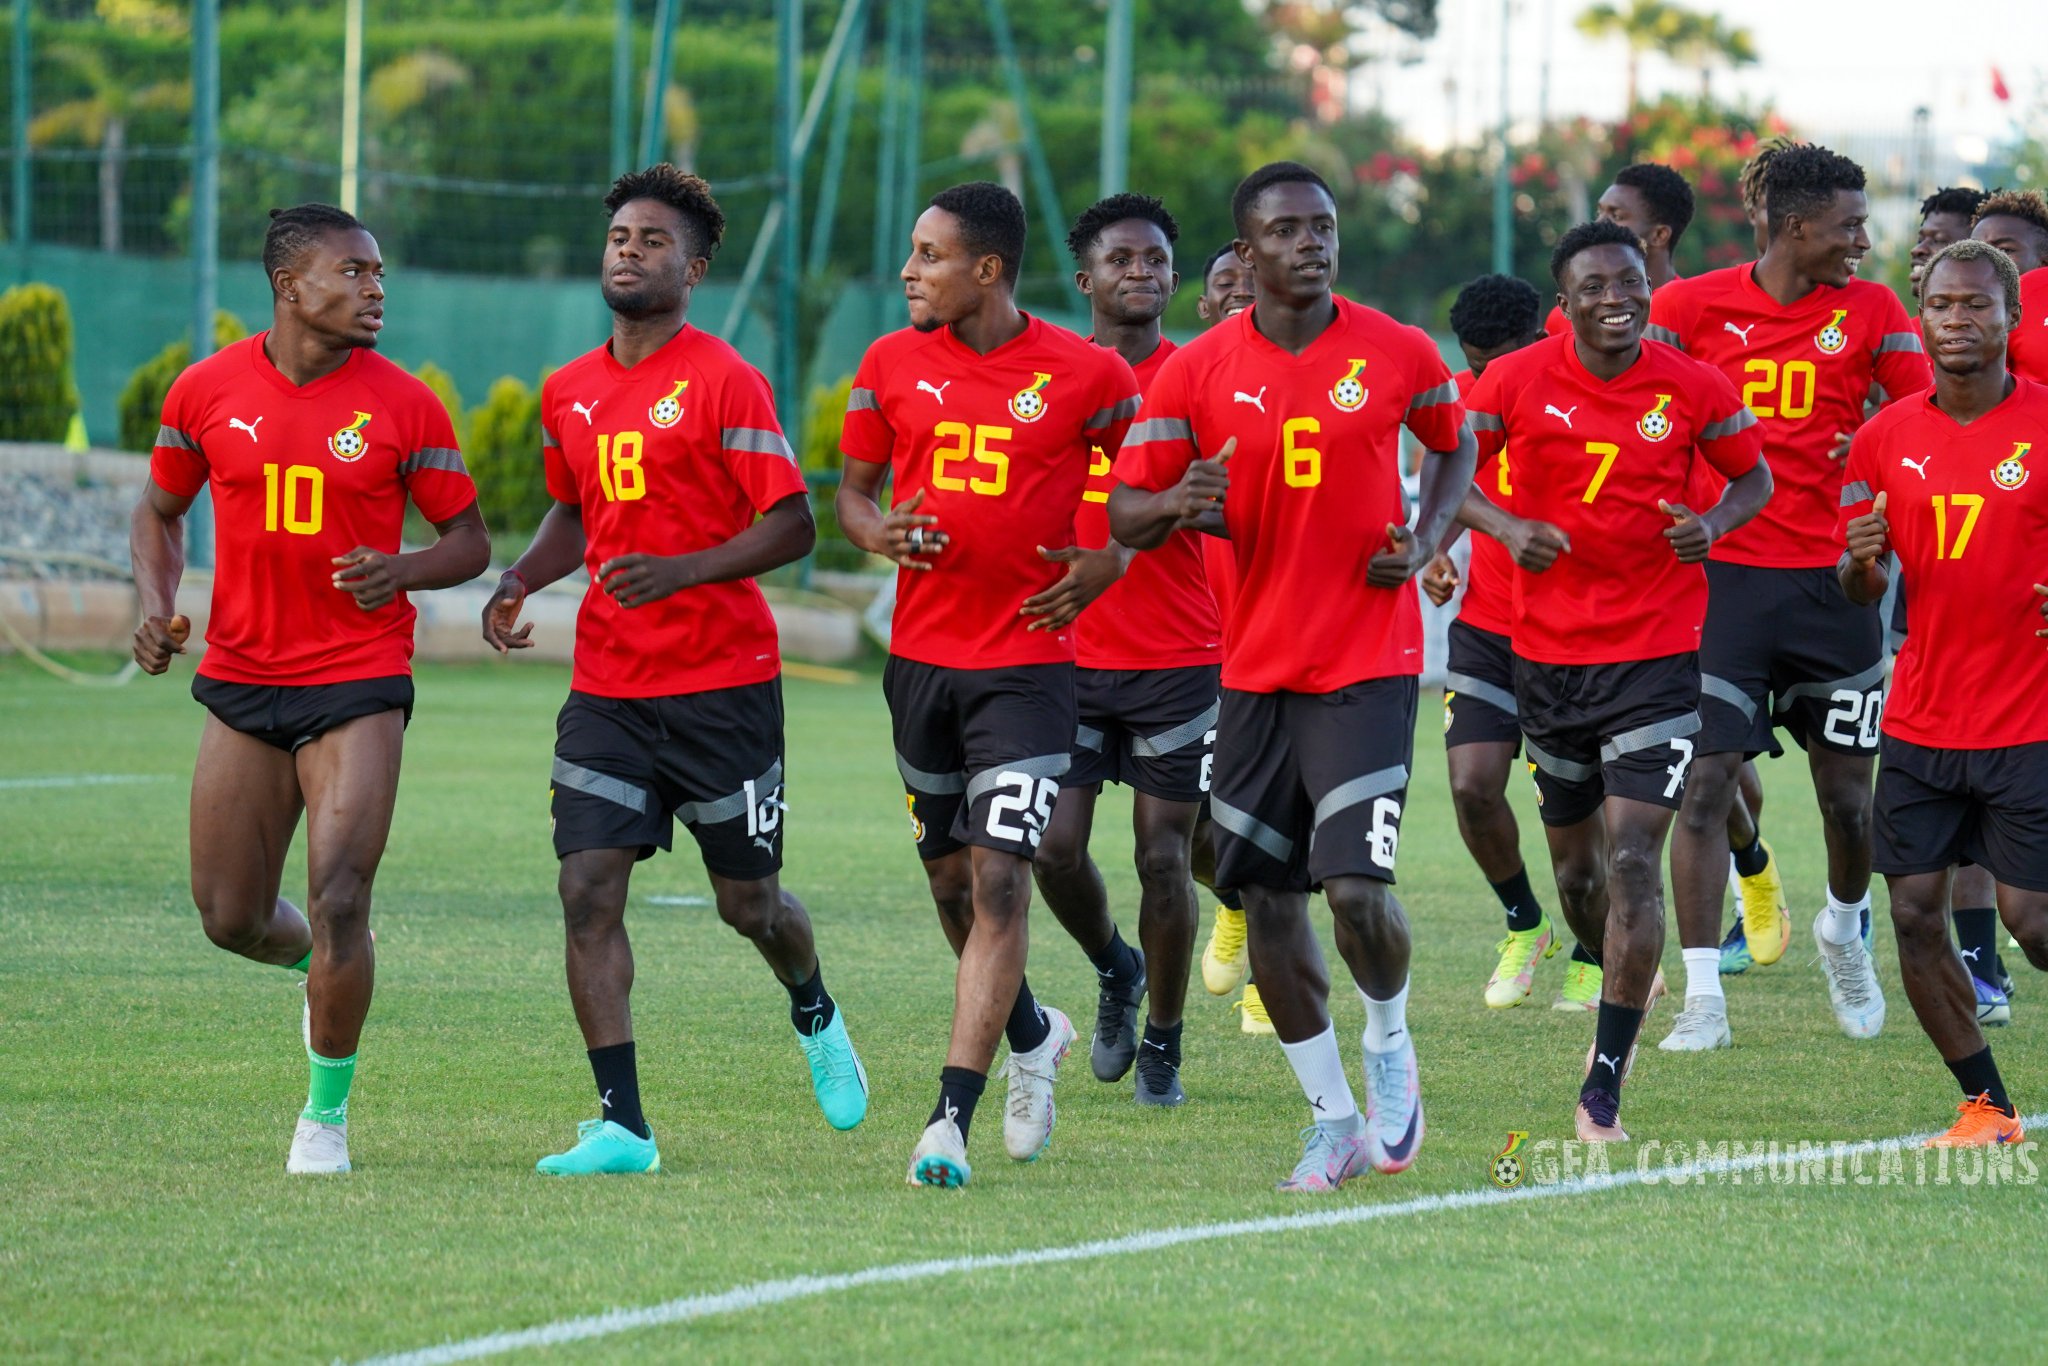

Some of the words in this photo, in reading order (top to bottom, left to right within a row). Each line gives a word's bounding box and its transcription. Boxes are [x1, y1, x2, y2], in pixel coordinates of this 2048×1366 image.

[1742, 358, 1816, 419] 20
[597, 430, 646, 502] 18
[931, 421, 1013, 496] 25
[1282, 416, 1322, 488] 6
[1581, 441, 1620, 504] 7
[263, 463, 324, 535] 10
[1931, 493, 1985, 560] 17
[1823, 689, 1883, 748] 20
[1663, 737, 1694, 799] 7
[985, 770, 1060, 848] 25
[1370, 796, 1401, 871] 6
